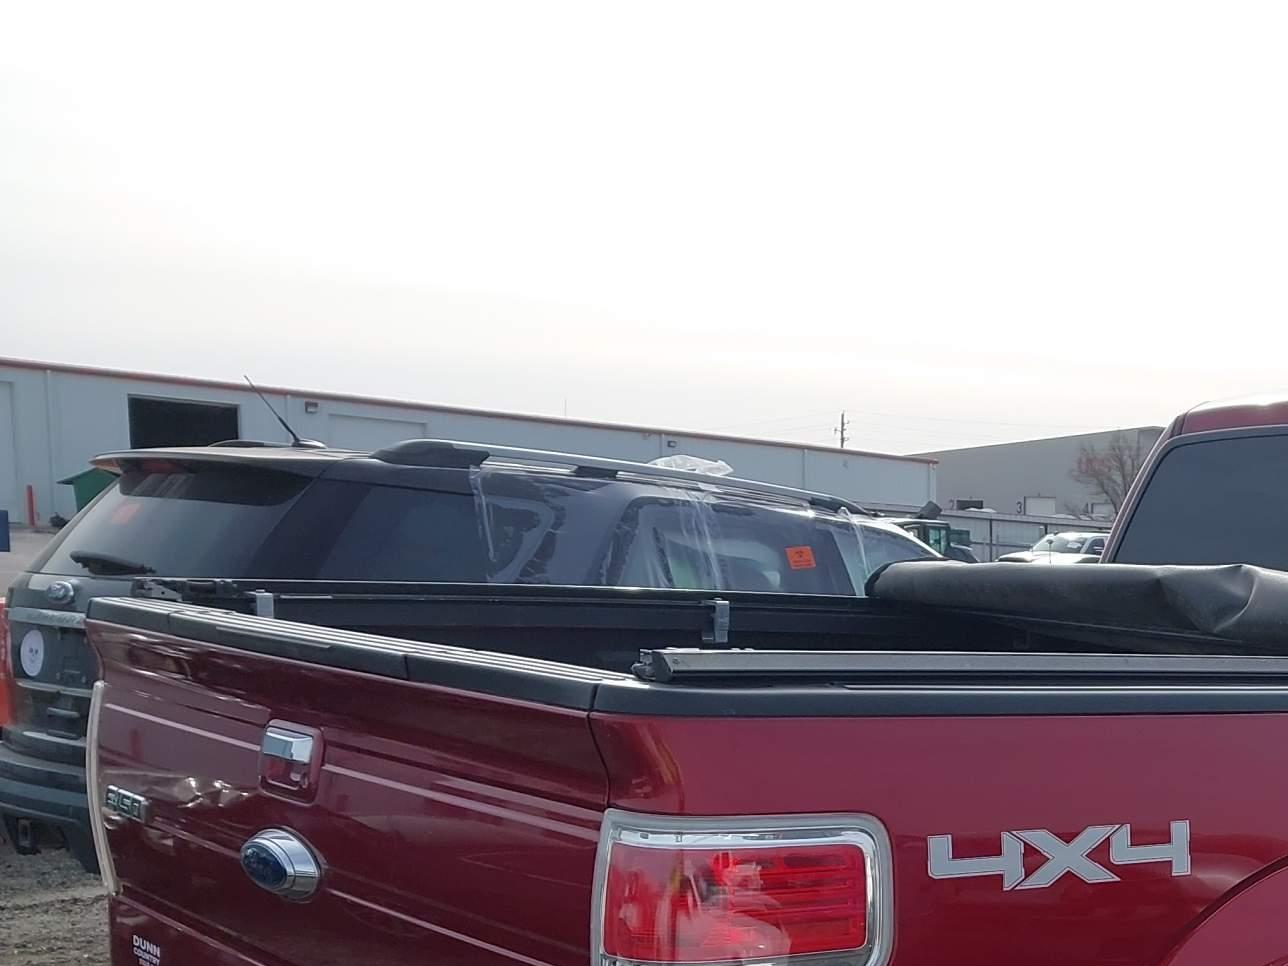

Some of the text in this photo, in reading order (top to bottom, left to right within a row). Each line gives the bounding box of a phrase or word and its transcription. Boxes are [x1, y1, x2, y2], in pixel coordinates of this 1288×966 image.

[1016, 501, 1024, 514] 3
[132, 934, 160, 957] DUNN
[133, 947, 160, 966] COUNTRY
